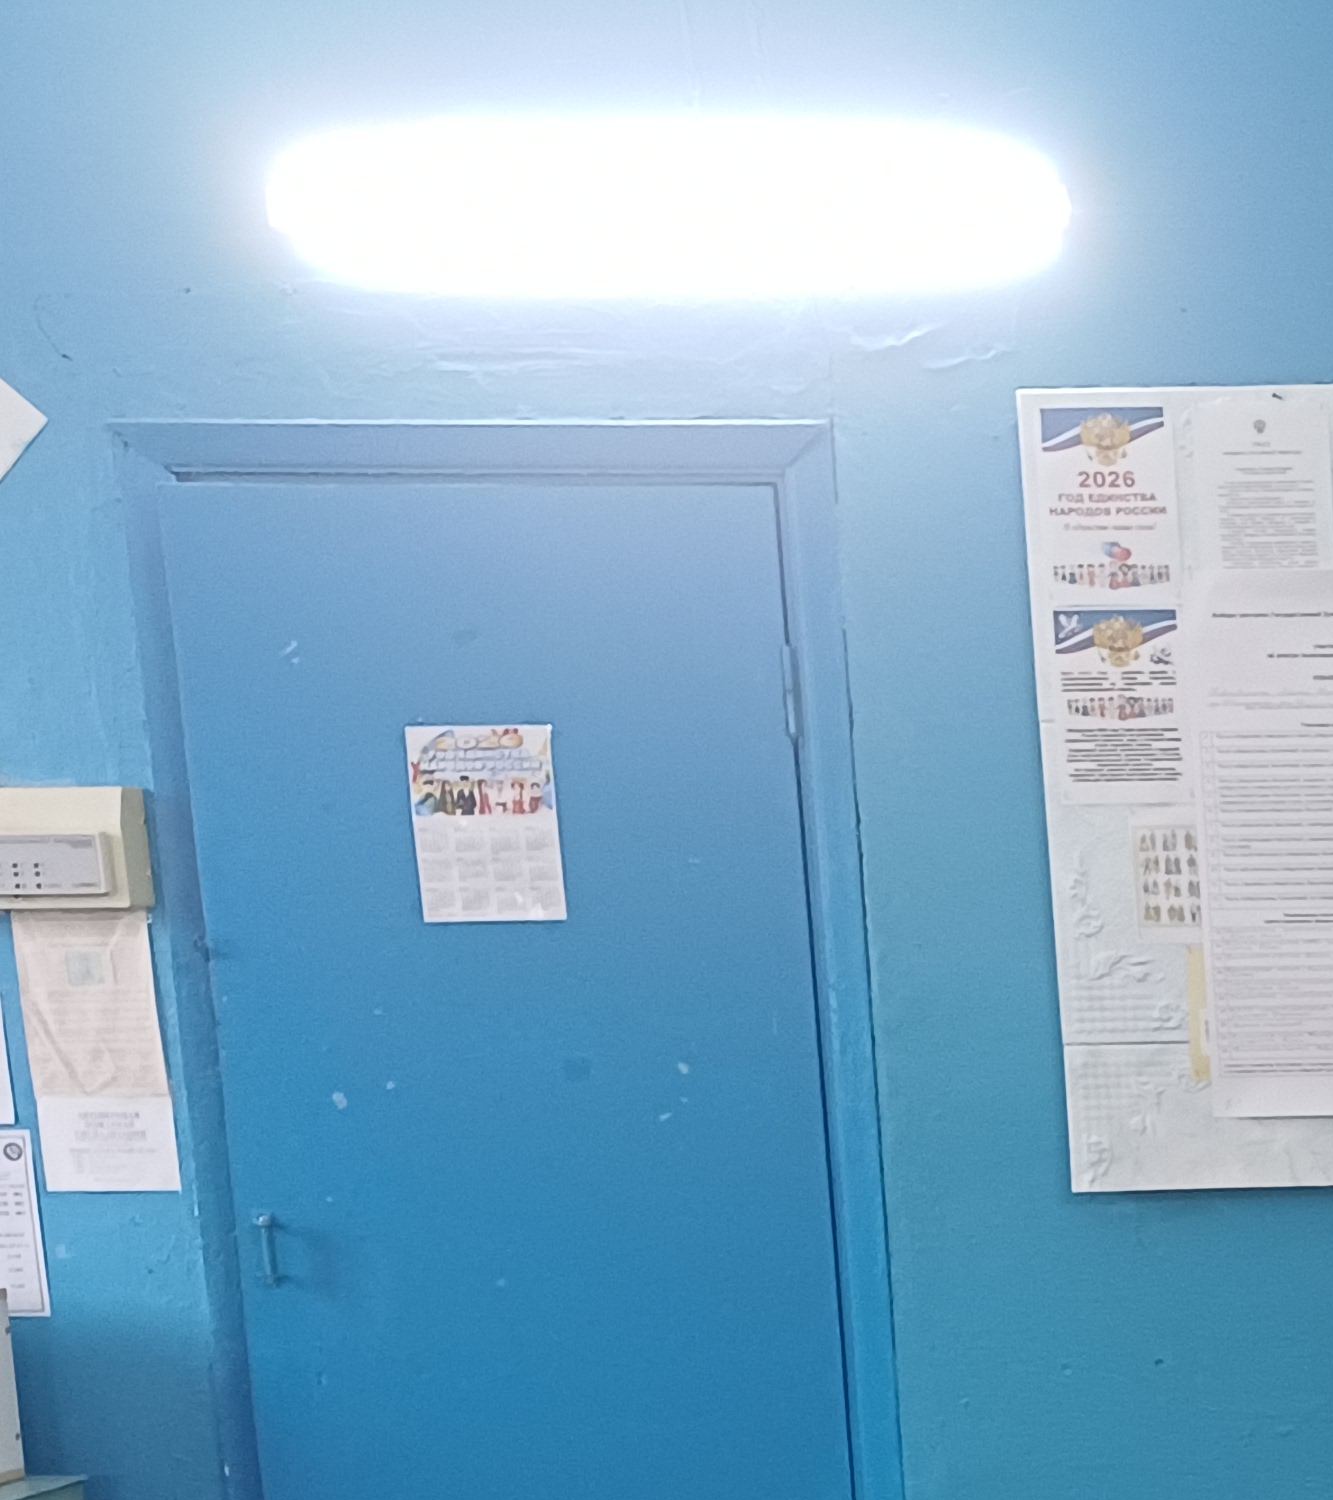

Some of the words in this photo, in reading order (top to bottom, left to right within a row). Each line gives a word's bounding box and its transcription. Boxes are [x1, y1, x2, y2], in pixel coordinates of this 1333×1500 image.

[1077, 470, 1136, 488] 2026
[1058, 492, 1085, 504] ГОД
[1049, 507, 1112, 517] НАРОДОВ
[1115, 506, 1167, 516] РОССИИ
